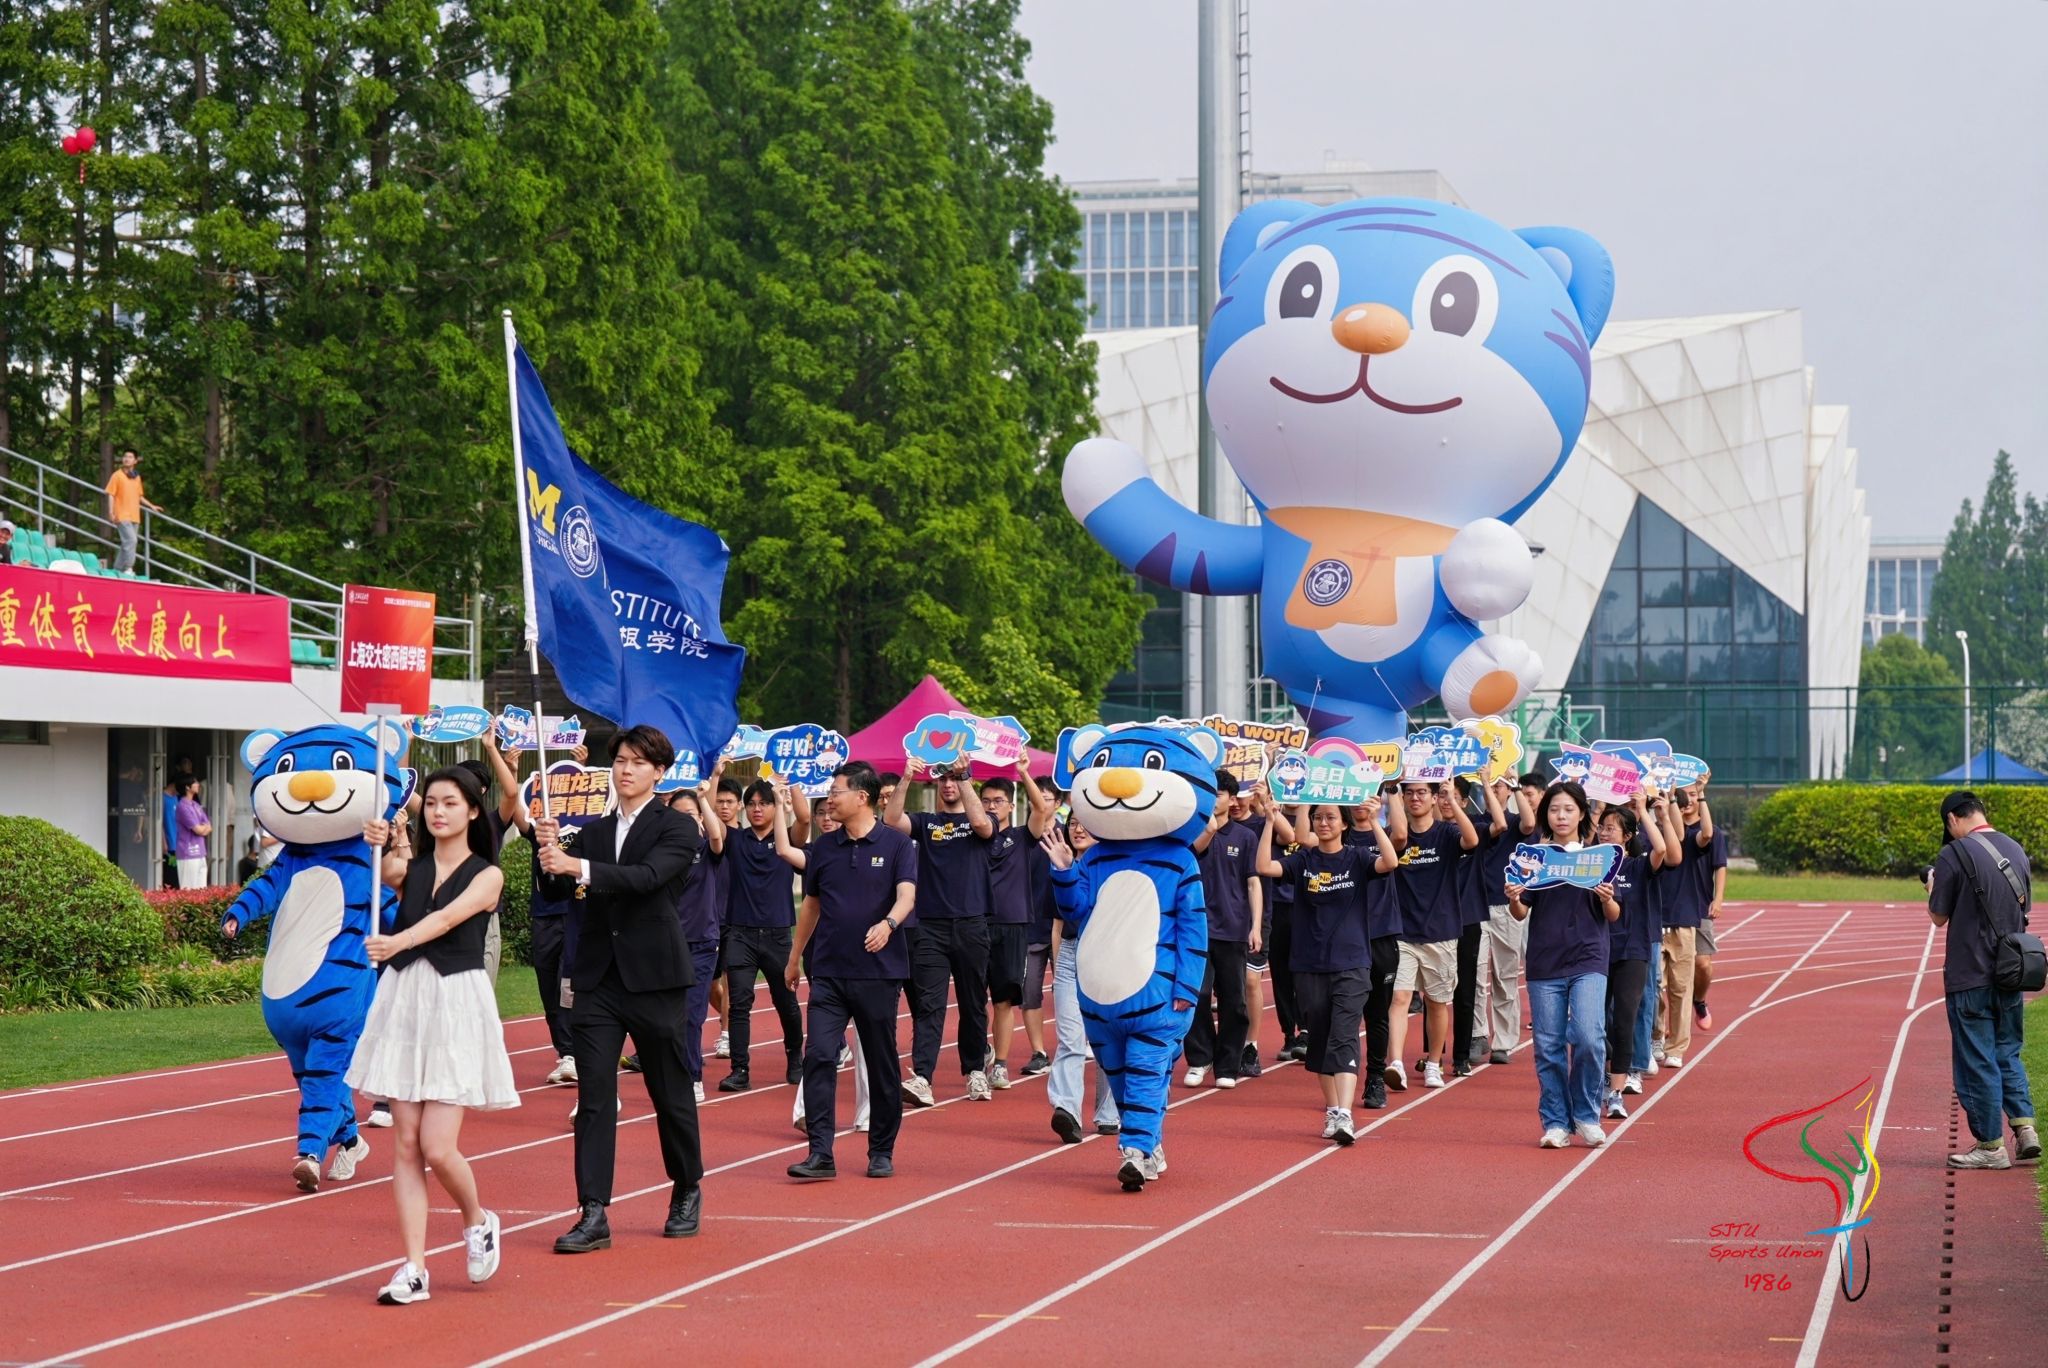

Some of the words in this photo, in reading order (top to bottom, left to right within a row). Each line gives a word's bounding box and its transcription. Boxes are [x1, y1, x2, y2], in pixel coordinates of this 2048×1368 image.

[527, 466, 562, 536] M
[0, 588, 95, 658] 重体育
[111, 600, 236, 662] 健康向上
[619, 625, 710, 660] 根学院
[347, 640, 427, 673] 上海交大密西根学院
[918, 729, 928, 748] I
[1244, 723, 1306, 748] world
[1438, 733, 1474, 751] 全力
[775, 738, 810, 757] 以赴
[1385, 754, 1395, 763] JI
[1444, 750, 1479, 767] 以赴
[778, 759, 812, 778] 全力
[1310, 766, 1346, 784] 春日
[531, 771, 610, 796] 闪耀龙宾
[1576, 853, 1604, 865] 稳住
